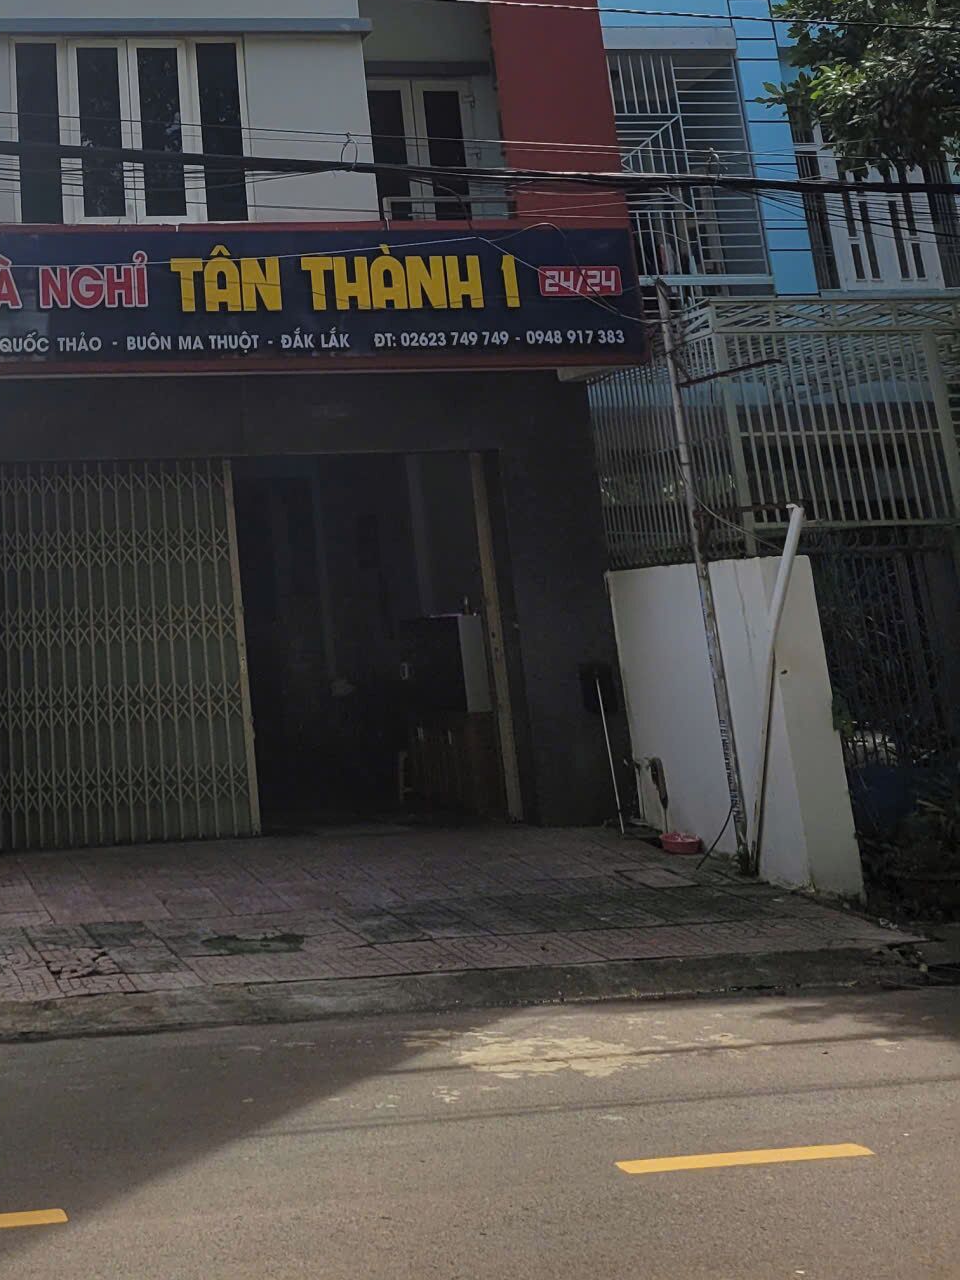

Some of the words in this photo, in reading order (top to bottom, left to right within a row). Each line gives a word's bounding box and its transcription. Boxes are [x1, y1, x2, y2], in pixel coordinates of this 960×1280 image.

[39, 250, 149, 309] NGHỈ
[170, 244, 283, 312] TÂN
[300, 243, 485, 311] THÀNH
[500, 254, 521, 308] 1
[544, 269, 616, 293] 24/24
[57, 331, 103, 352] THẢO
[126, 331, 172, 351] BUÔN
[178, 334, 204, 351] MA
[208, 330, 260, 354] THUỘT
[280, 326, 316, 349] ĐẮK
[320, 326, 351, 349] LẮK
[373, 332, 397, 348] ĐT:
[400, 332, 447, 347] 02623
[451, 331, 479, 346] 749
[482, 330, 510, 346] 749
[526, 329, 563, 345] 0948
[569, 329, 594, 344] 917
[597, 329, 626, 344] 383
